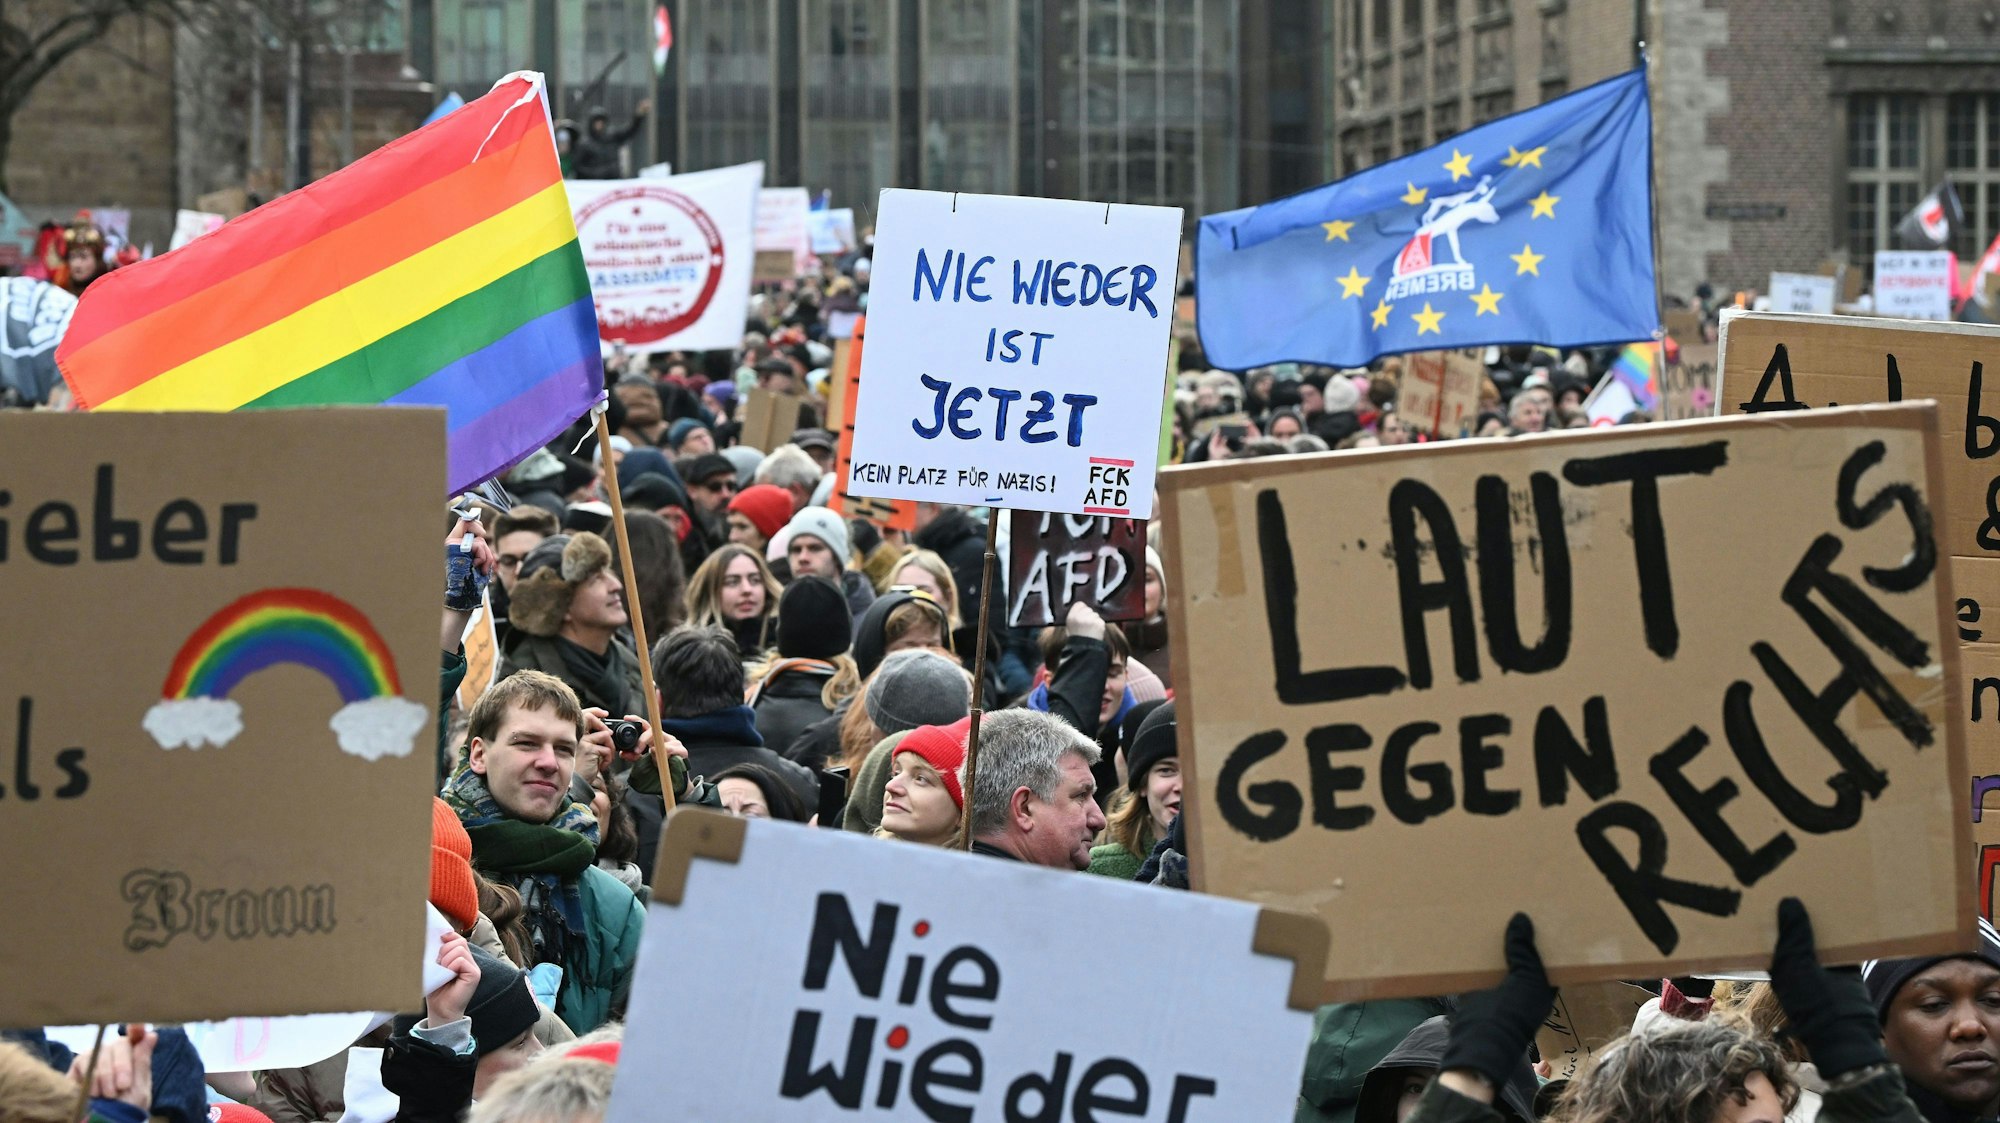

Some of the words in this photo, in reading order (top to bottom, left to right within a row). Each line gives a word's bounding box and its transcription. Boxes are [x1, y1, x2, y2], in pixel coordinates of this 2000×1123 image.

[913, 248, 995, 302] NIE
[1013, 259, 1158, 318] WIEDER
[986, 328, 1054, 365] IST
[912, 373, 1097, 447] JETZT
[853, 462, 892, 484] KEIN
[899, 465, 948, 486] PLATZ
[958, 466, 989, 488] FÜR
[997, 472, 1056, 493] NAZIS!
[1083, 487, 1128, 507] AFD
[1089, 466, 1130, 486] FCK
[1009, 546, 1128, 628] AFD
[1257, 440, 1730, 705] LAUT
[1575, 440, 1938, 957] RECHTS
[1215, 695, 1620, 843] GEGEN
[120, 868, 338, 952] Braun
[802, 891, 1000, 1031] Nie
